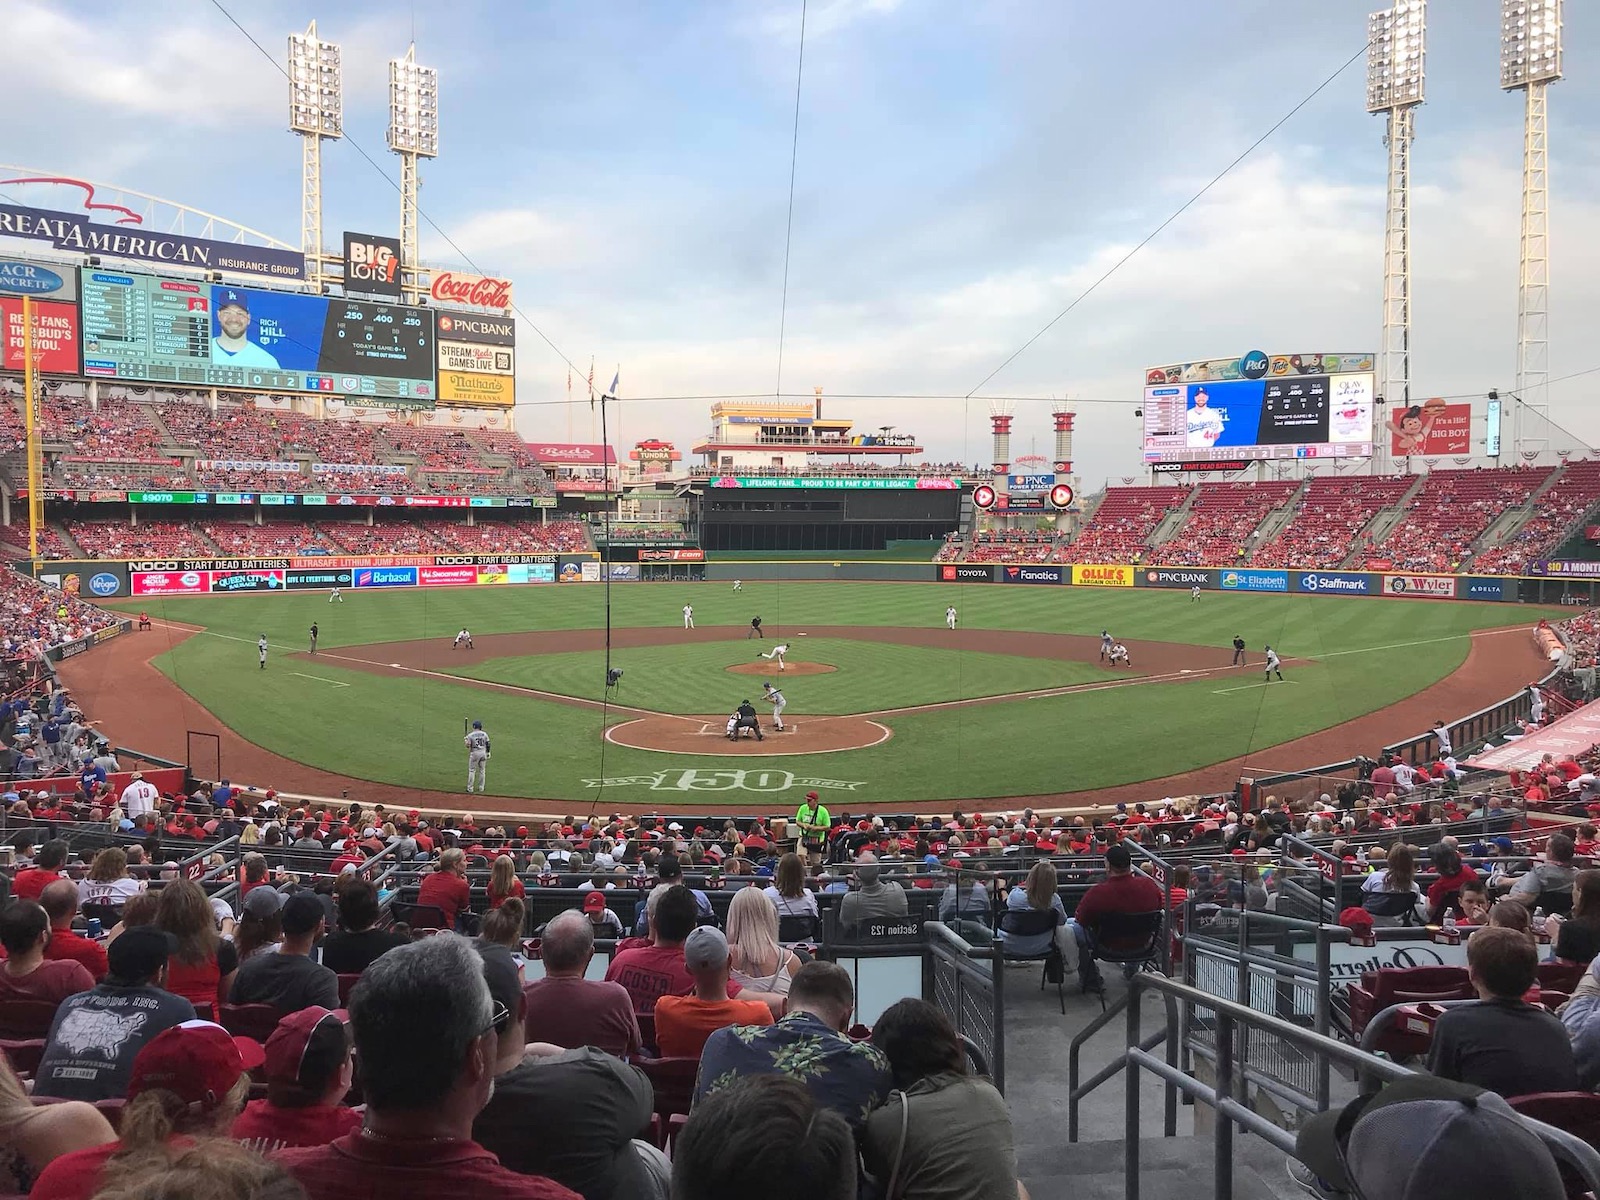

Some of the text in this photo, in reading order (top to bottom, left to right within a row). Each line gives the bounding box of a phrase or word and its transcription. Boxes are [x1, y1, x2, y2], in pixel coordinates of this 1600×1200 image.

[0, 213, 299, 275] REAT AMERICAN INSURANCE GROUP
[350, 242, 393, 266] BIG
[1, 264, 36, 278] ACR
[351, 256, 398, 283] LOTS!
[432, 272, 512, 309] Coca-Cola
[41, 316, 72, 330] FANS,
[260, 319, 278, 327] RICH
[344, 311, 421, 326] .250 .400 .250
[39, 328, 72, 340] BUD'S
[260, 328, 286, 337] HILL
[454, 319, 512, 337] PNC BANK
[338, 330, 425, 346] 0 0 1 0
[37, 340, 61, 351] YOU.
[441, 346, 493, 359] STREAM Reds
[449, 357, 492, 370] GAMES LIVE
[1246, 360, 1266, 371] P&G
[1272, 360, 1289, 373] Tide
[253, 375, 295, 386] 0 1 2
[450, 374, 503, 390] Nathan's
[1340, 381, 1361, 389] OLAY
[347, 400, 385, 408] ULTIMATE
[1453, 416, 1466, 424] Hit!
[1431, 429, 1467, 438] BIG BOY
[884, 437, 914, 446] TriHealth
[540, 447, 594, 459] Reds
[1026, 476, 1047, 484] PNC
[143, 494, 173, 503] $9070
[129, 561, 178, 572] NOCO
[184, 561, 214, 570] START
[215, 560, 240, 570] DEAD
[294, 559, 337, 568] ULTRASAFE
[341, 558, 371, 567] LITHIUM
[373, 558, 394, 566] JUMP
[478, 556, 500, 564] START
[1547, 562, 1562, 571] $10
[1563, 563, 1569, 571] A
[373, 572, 411, 583] Barbasol
[958, 569, 987, 577] TOYOTA
[1021, 570, 1058, 580] Fanatics
[1159, 573, 1208, 583] PNC BANK
[93, 578, 117, 592] Kroger
[219, 576, 246, 587] QUEEN
[1249, 576, 1285, 584] Elizabeth
[1319, 577, 1365, 590] Staffmark
[1412, 579, 1452, 591] Wyler
[651, 769, 795, 790] 150
[188, 863, 201, 880] 22
[1155, 866, 1165, 882] 23
[1321, 861, 1333, 877] 24
[624, 970, 668, 994] COSTA
[133, 997, 160, 1009] INC.
